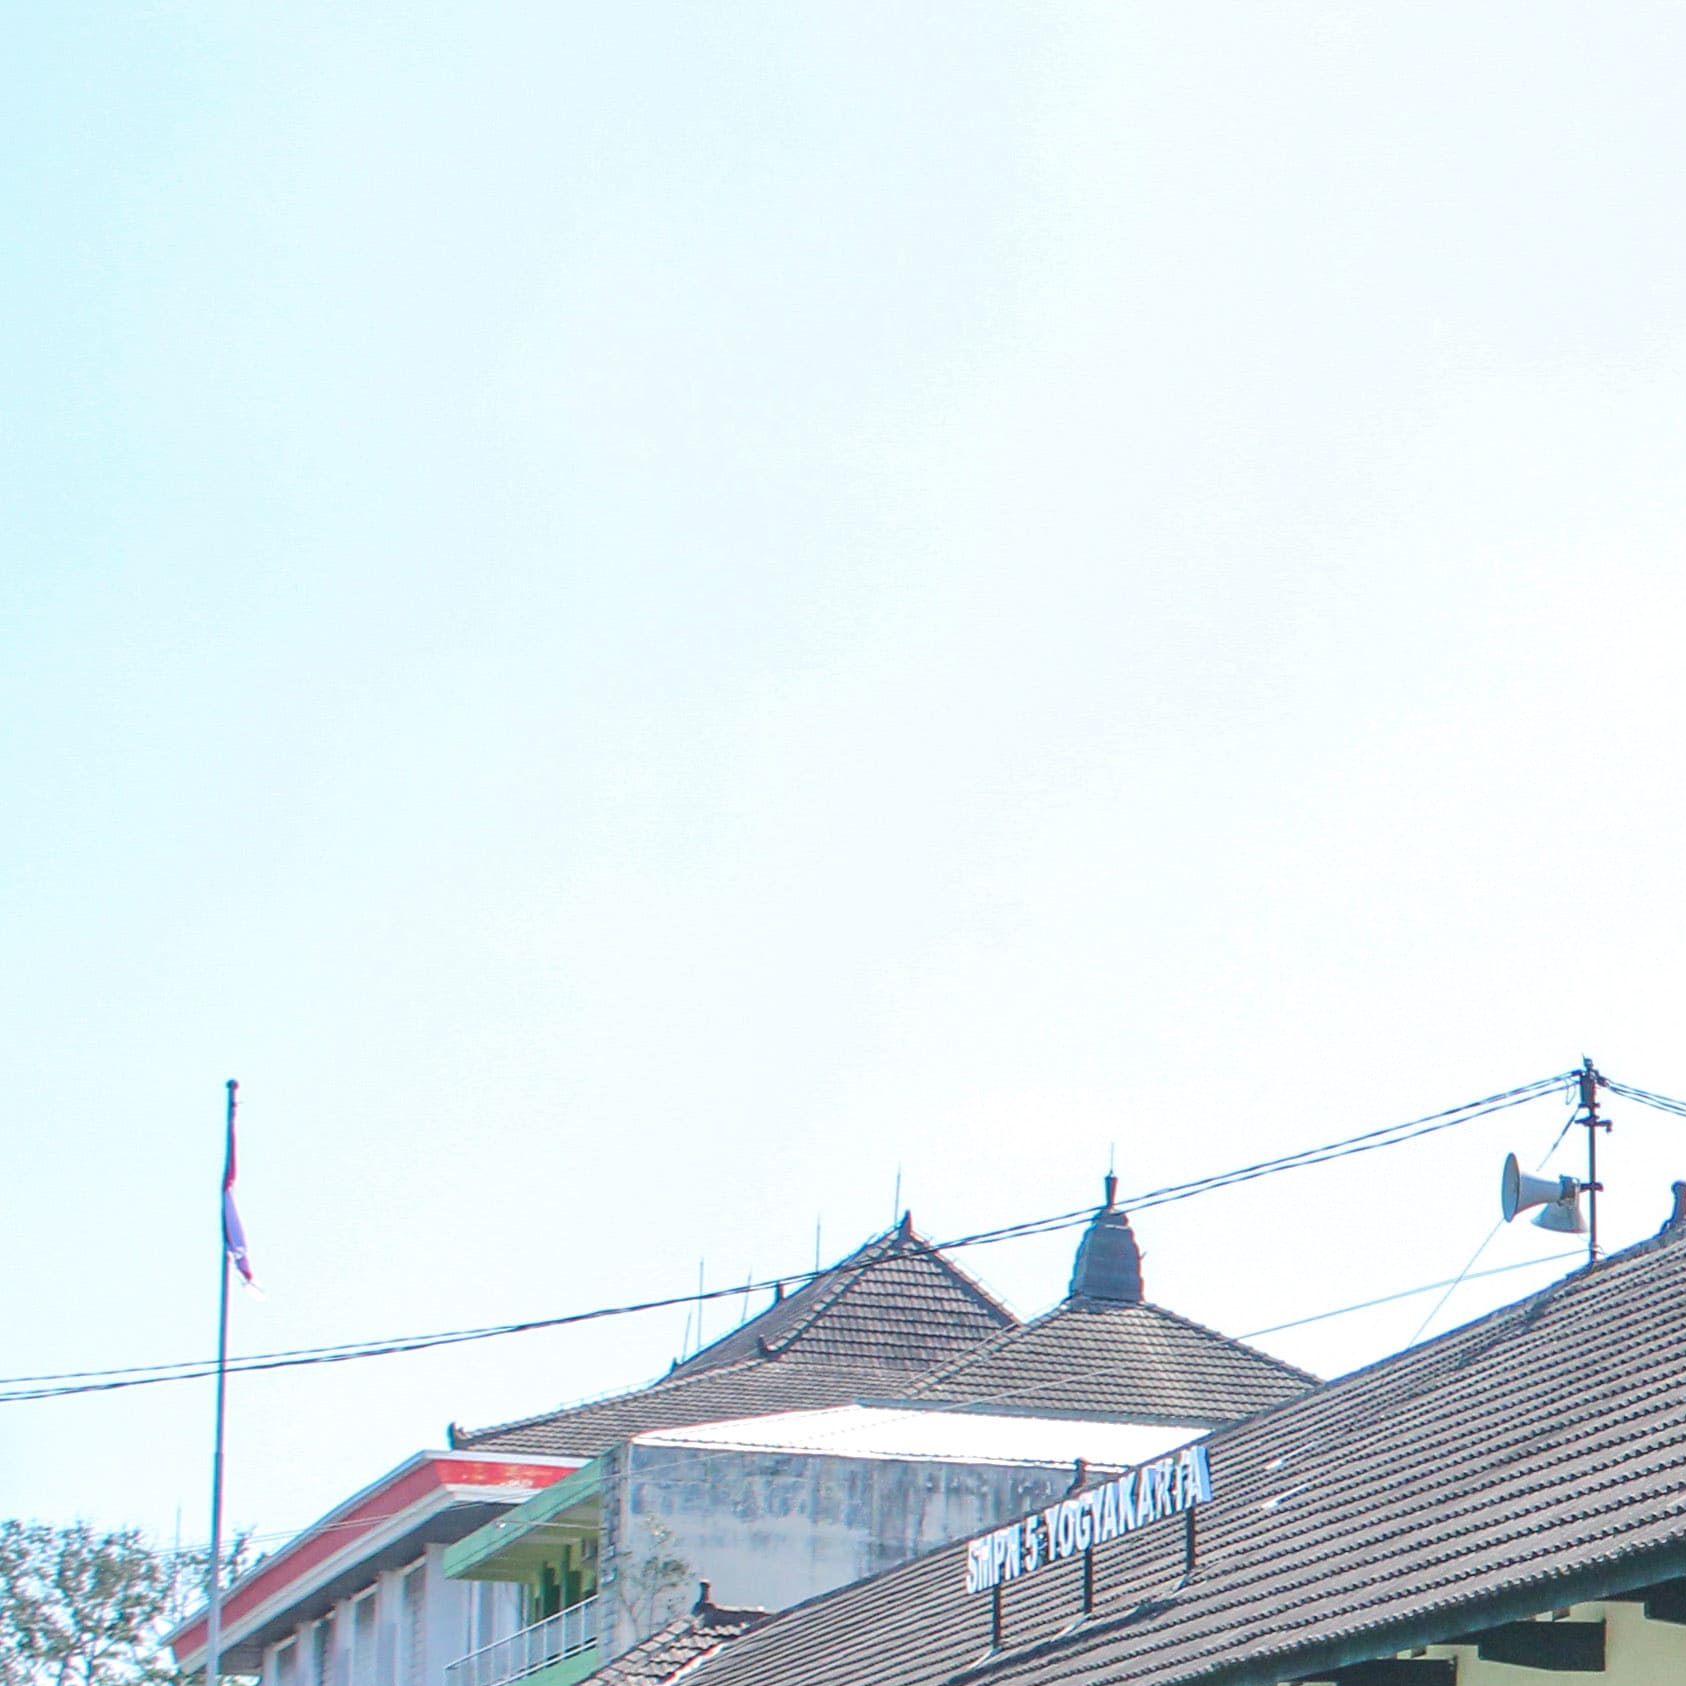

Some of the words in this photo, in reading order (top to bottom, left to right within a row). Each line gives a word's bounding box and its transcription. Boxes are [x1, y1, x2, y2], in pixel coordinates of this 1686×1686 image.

[966, 1523, 1023, 1594] SMPN
[1025, 1514, 1041, 1572] 5
[1044, 1445, 1212, 1561] YOGYAKARTA
